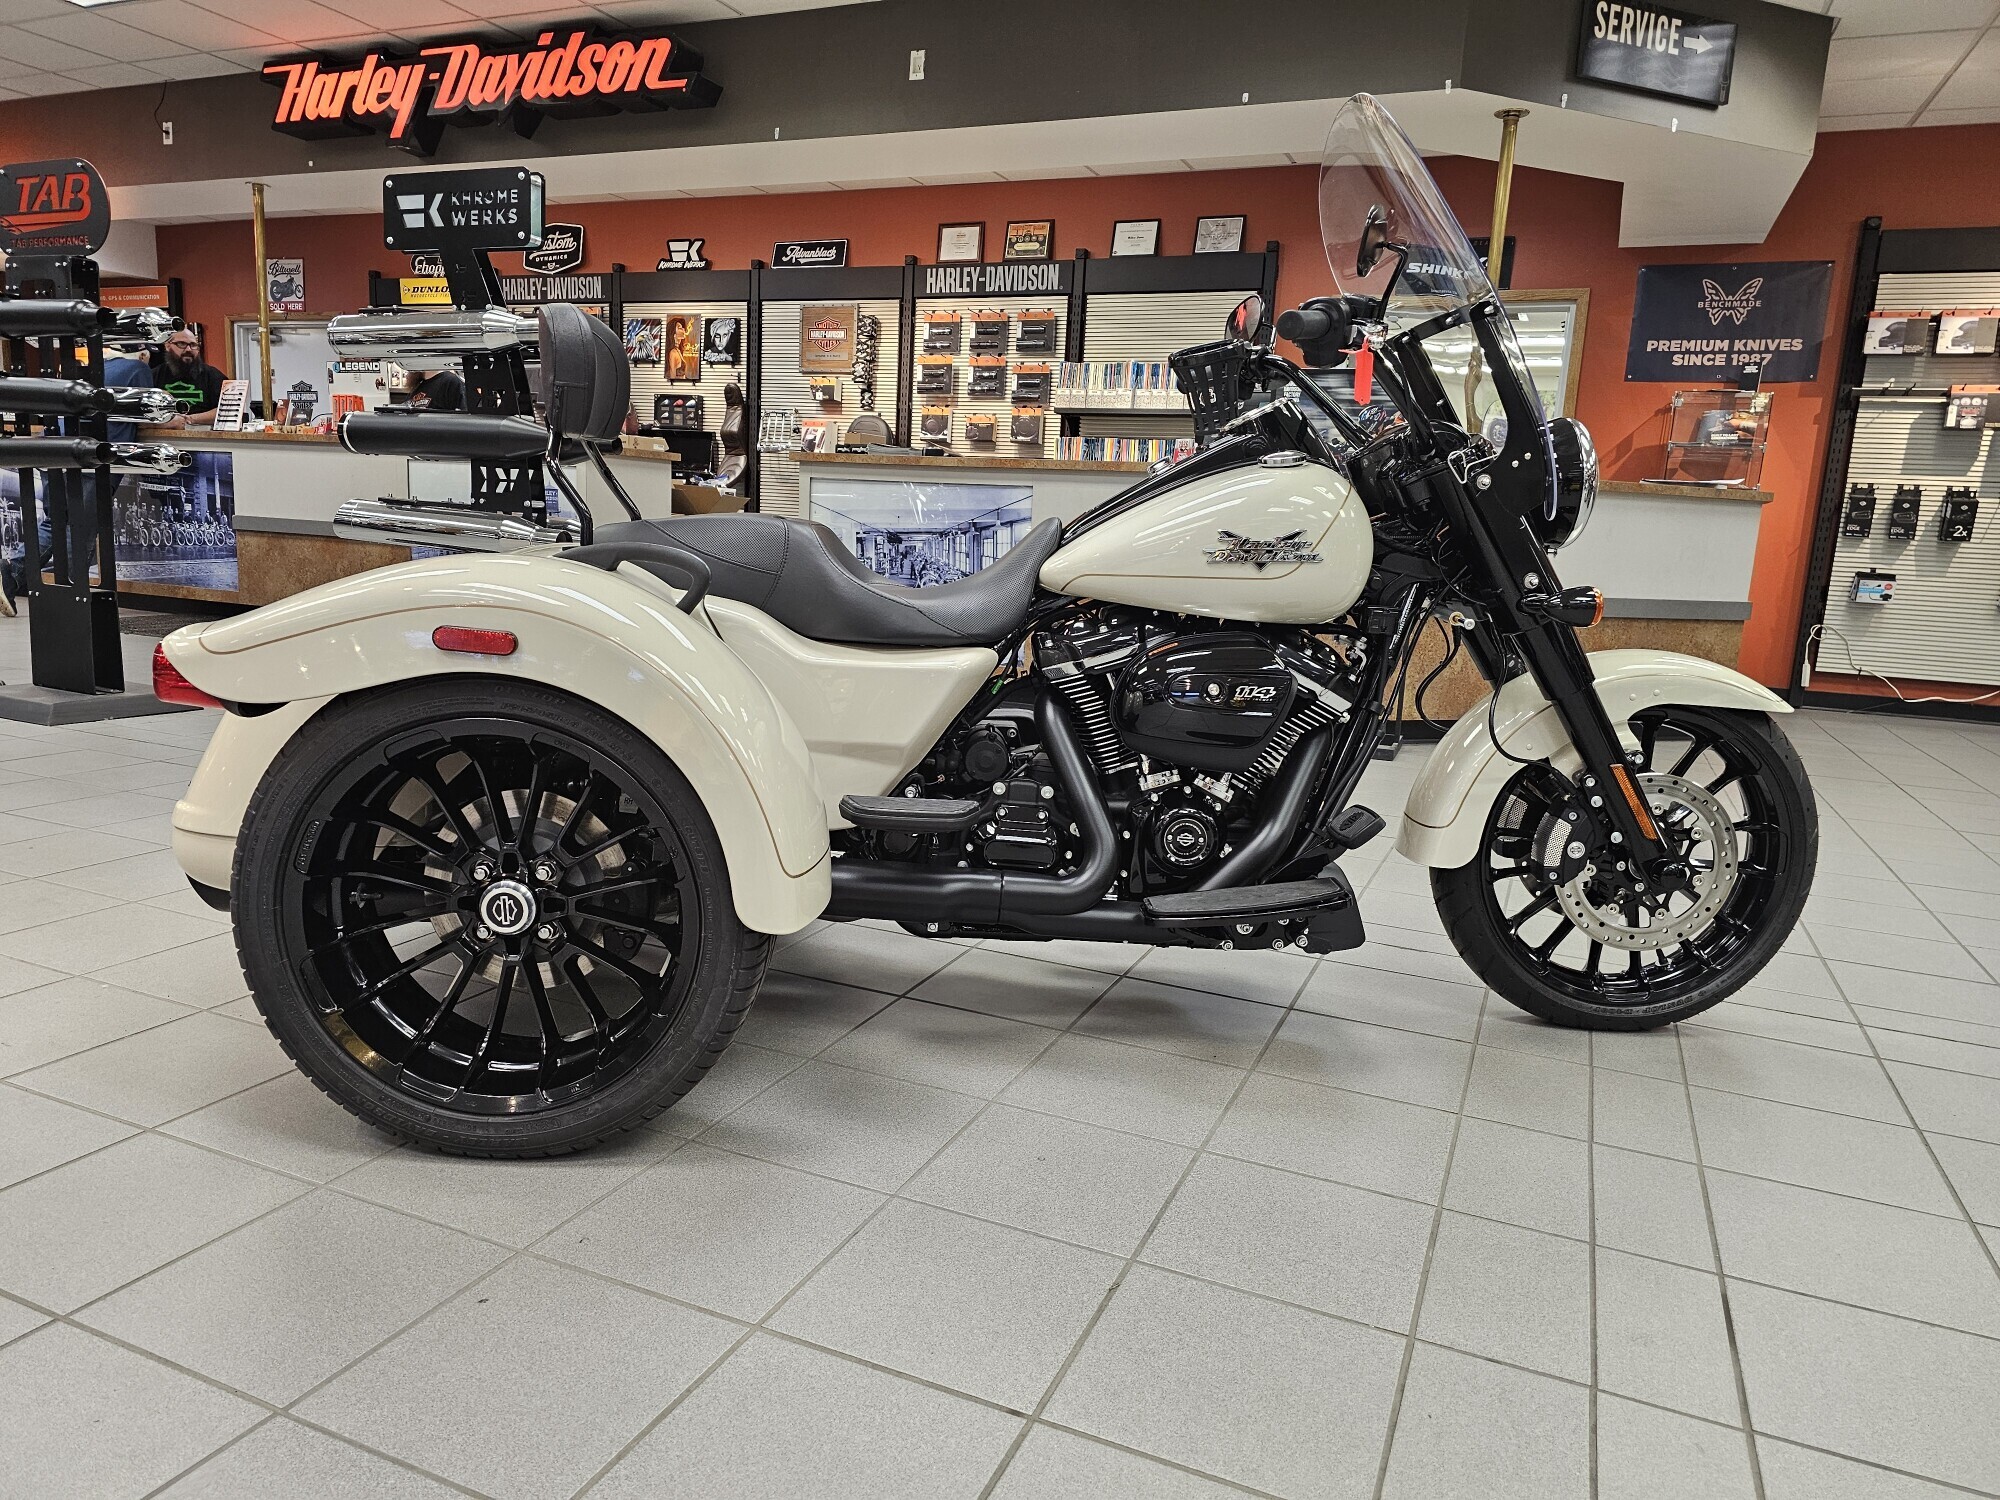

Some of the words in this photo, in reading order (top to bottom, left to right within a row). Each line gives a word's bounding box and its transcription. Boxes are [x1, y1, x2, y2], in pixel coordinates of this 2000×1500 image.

[1594, 1, 1682, 56] SERVICE
[263, 31, 688, 139] Harley-Davidson
[16, 172, 91, 213] TAB
[451, 189, 519, 206] KHROME
[451, 208, 518, 227] WERKS
[11, 238, 26, 249] TAB
[29, 235, 90, 249] PERFORMANCE
[542, 231, 577, 251] ustom
[535, 253, 568, 262] DYNAMICS
[926, 263, 1060, 295] HARLEY-DAVIDSON
[411, 285, 450, 294] DUNLO
[502, 276, 603, 301] HARLEY-DAVIDSON
[269, 303, 286, 311] SOLD
[287, 302, 303, 311] HERE
[1697, 299, 1762, 309] BENCHMADE
[1646, 339, 1730, 352] PREMIUM
[1733, 338, 1804, 351] KNIVES
[339, 361, 380, 371] LEGEND
[1671, 353, 1726, 366] SINCE
[1731, 353, 1773, 366] 1987
[1952, 525, 1968, 538] 2x
[1234, 685, 1277, 699] 114
